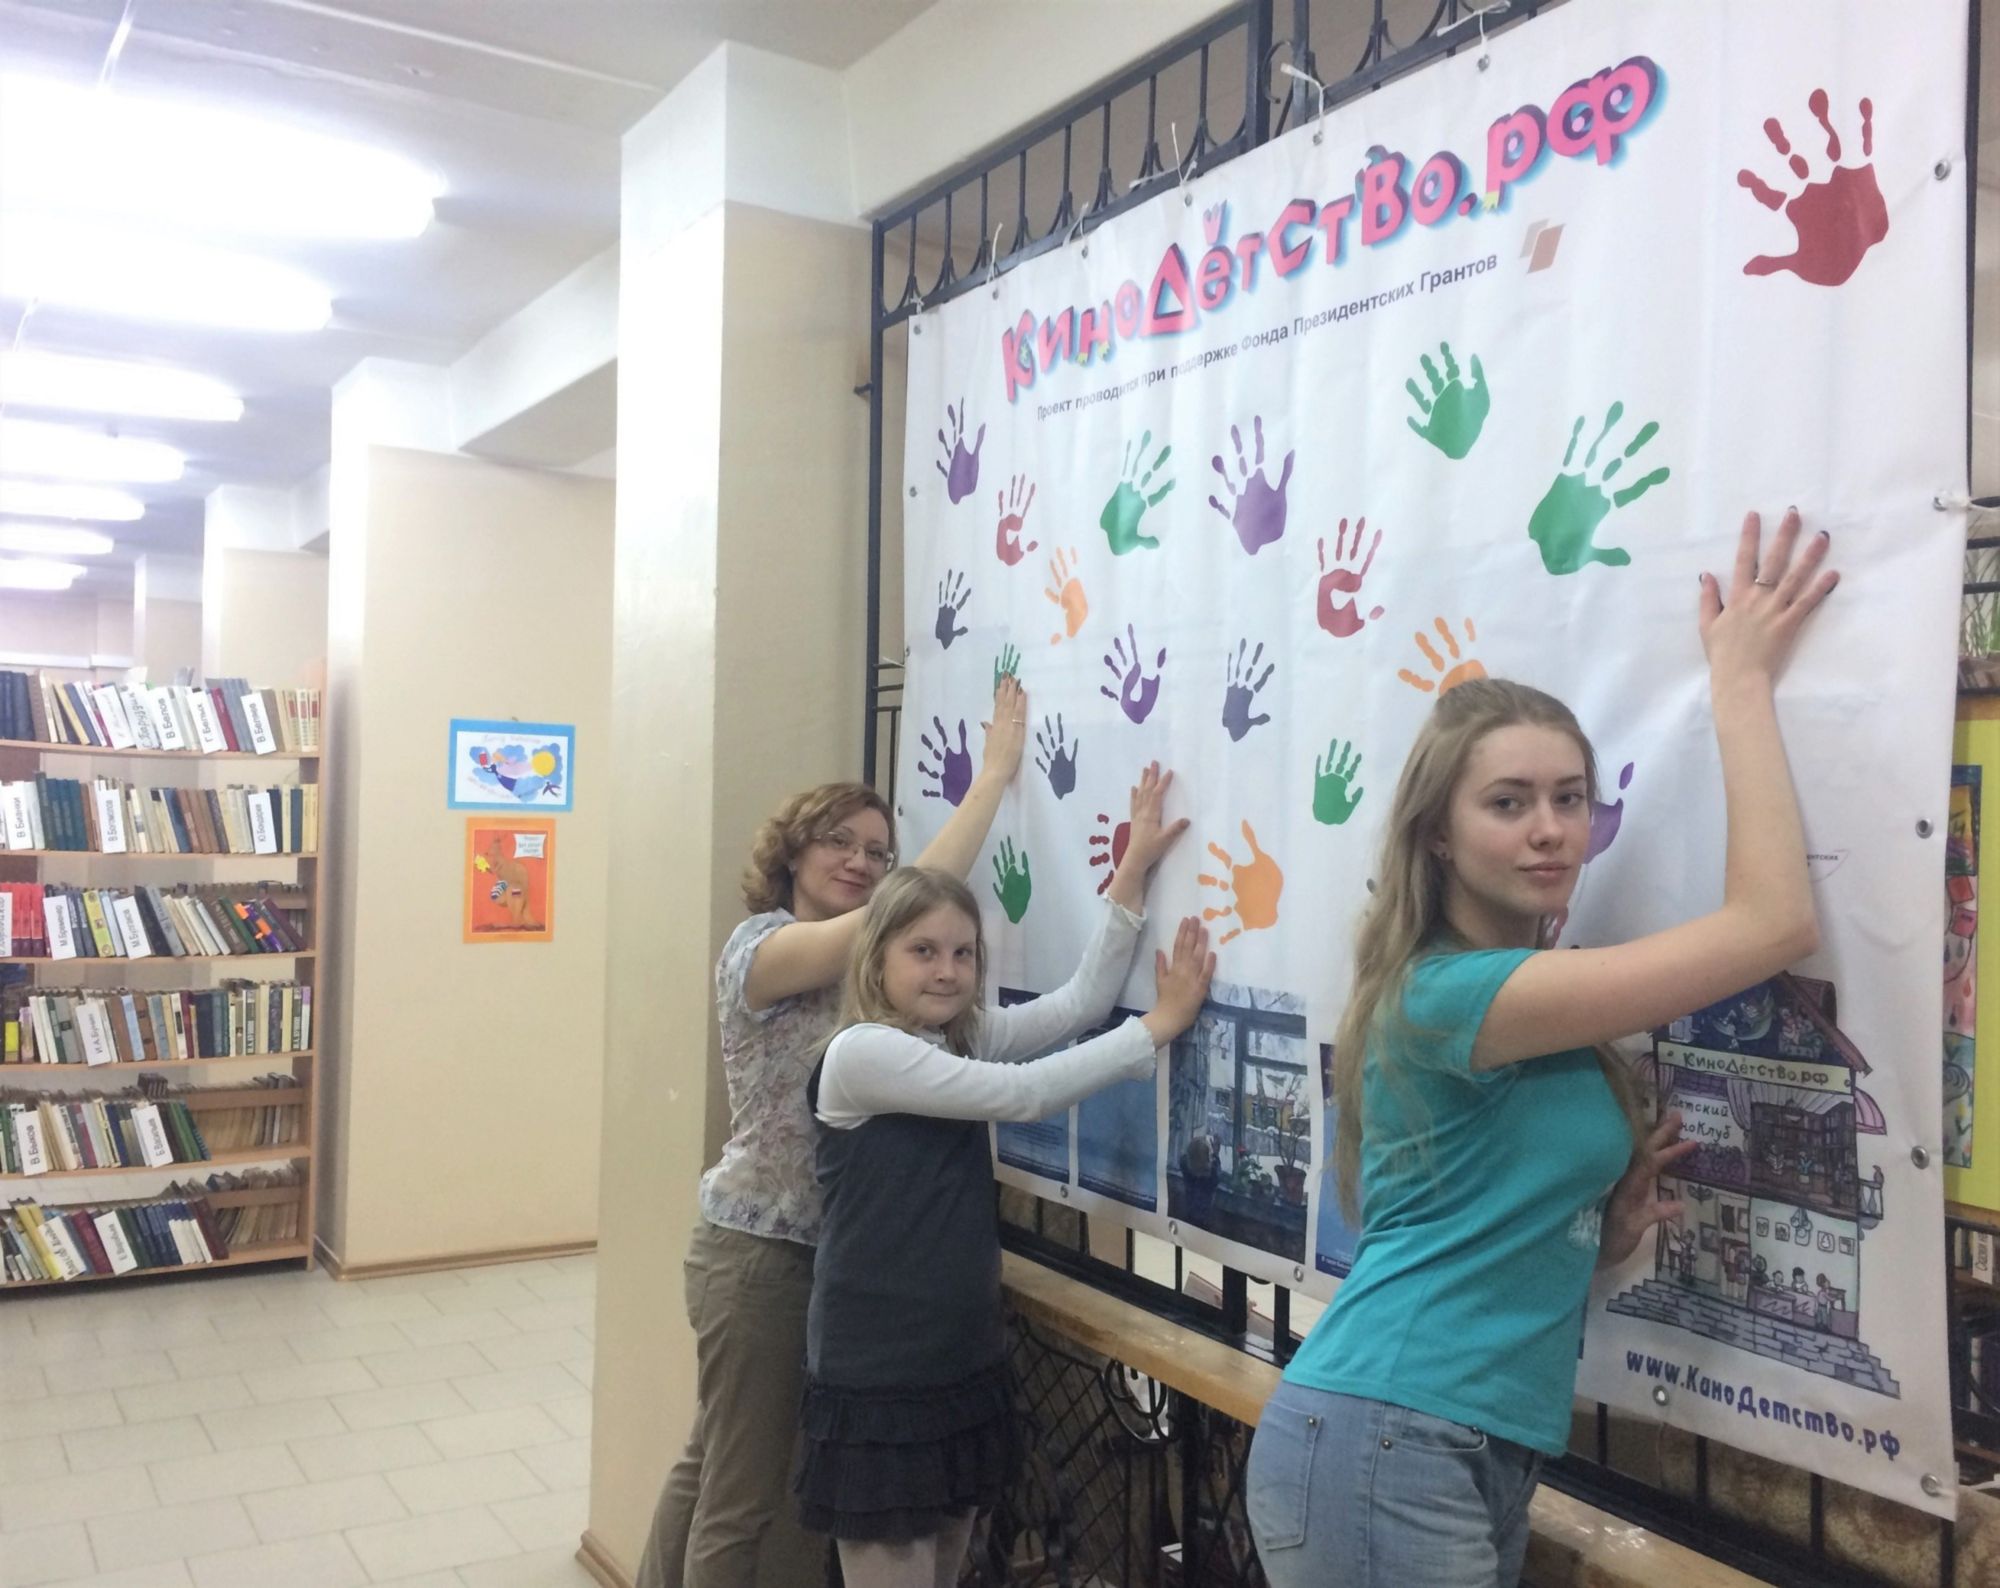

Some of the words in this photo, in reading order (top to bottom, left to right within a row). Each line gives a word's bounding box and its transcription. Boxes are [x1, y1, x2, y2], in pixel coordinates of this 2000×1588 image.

[1037, 401, 1073, 421] Проект
[1075, 377, 1138, 409] проводится
[1141, 367, 1166, 386] при
[1171, 344, 1238, 379] поддержке
[1241, 325, 1289, 351] Фонда
[1294, 281, 1415, 336] Президентских
[1420, 254, 1498, 293] Грантов
